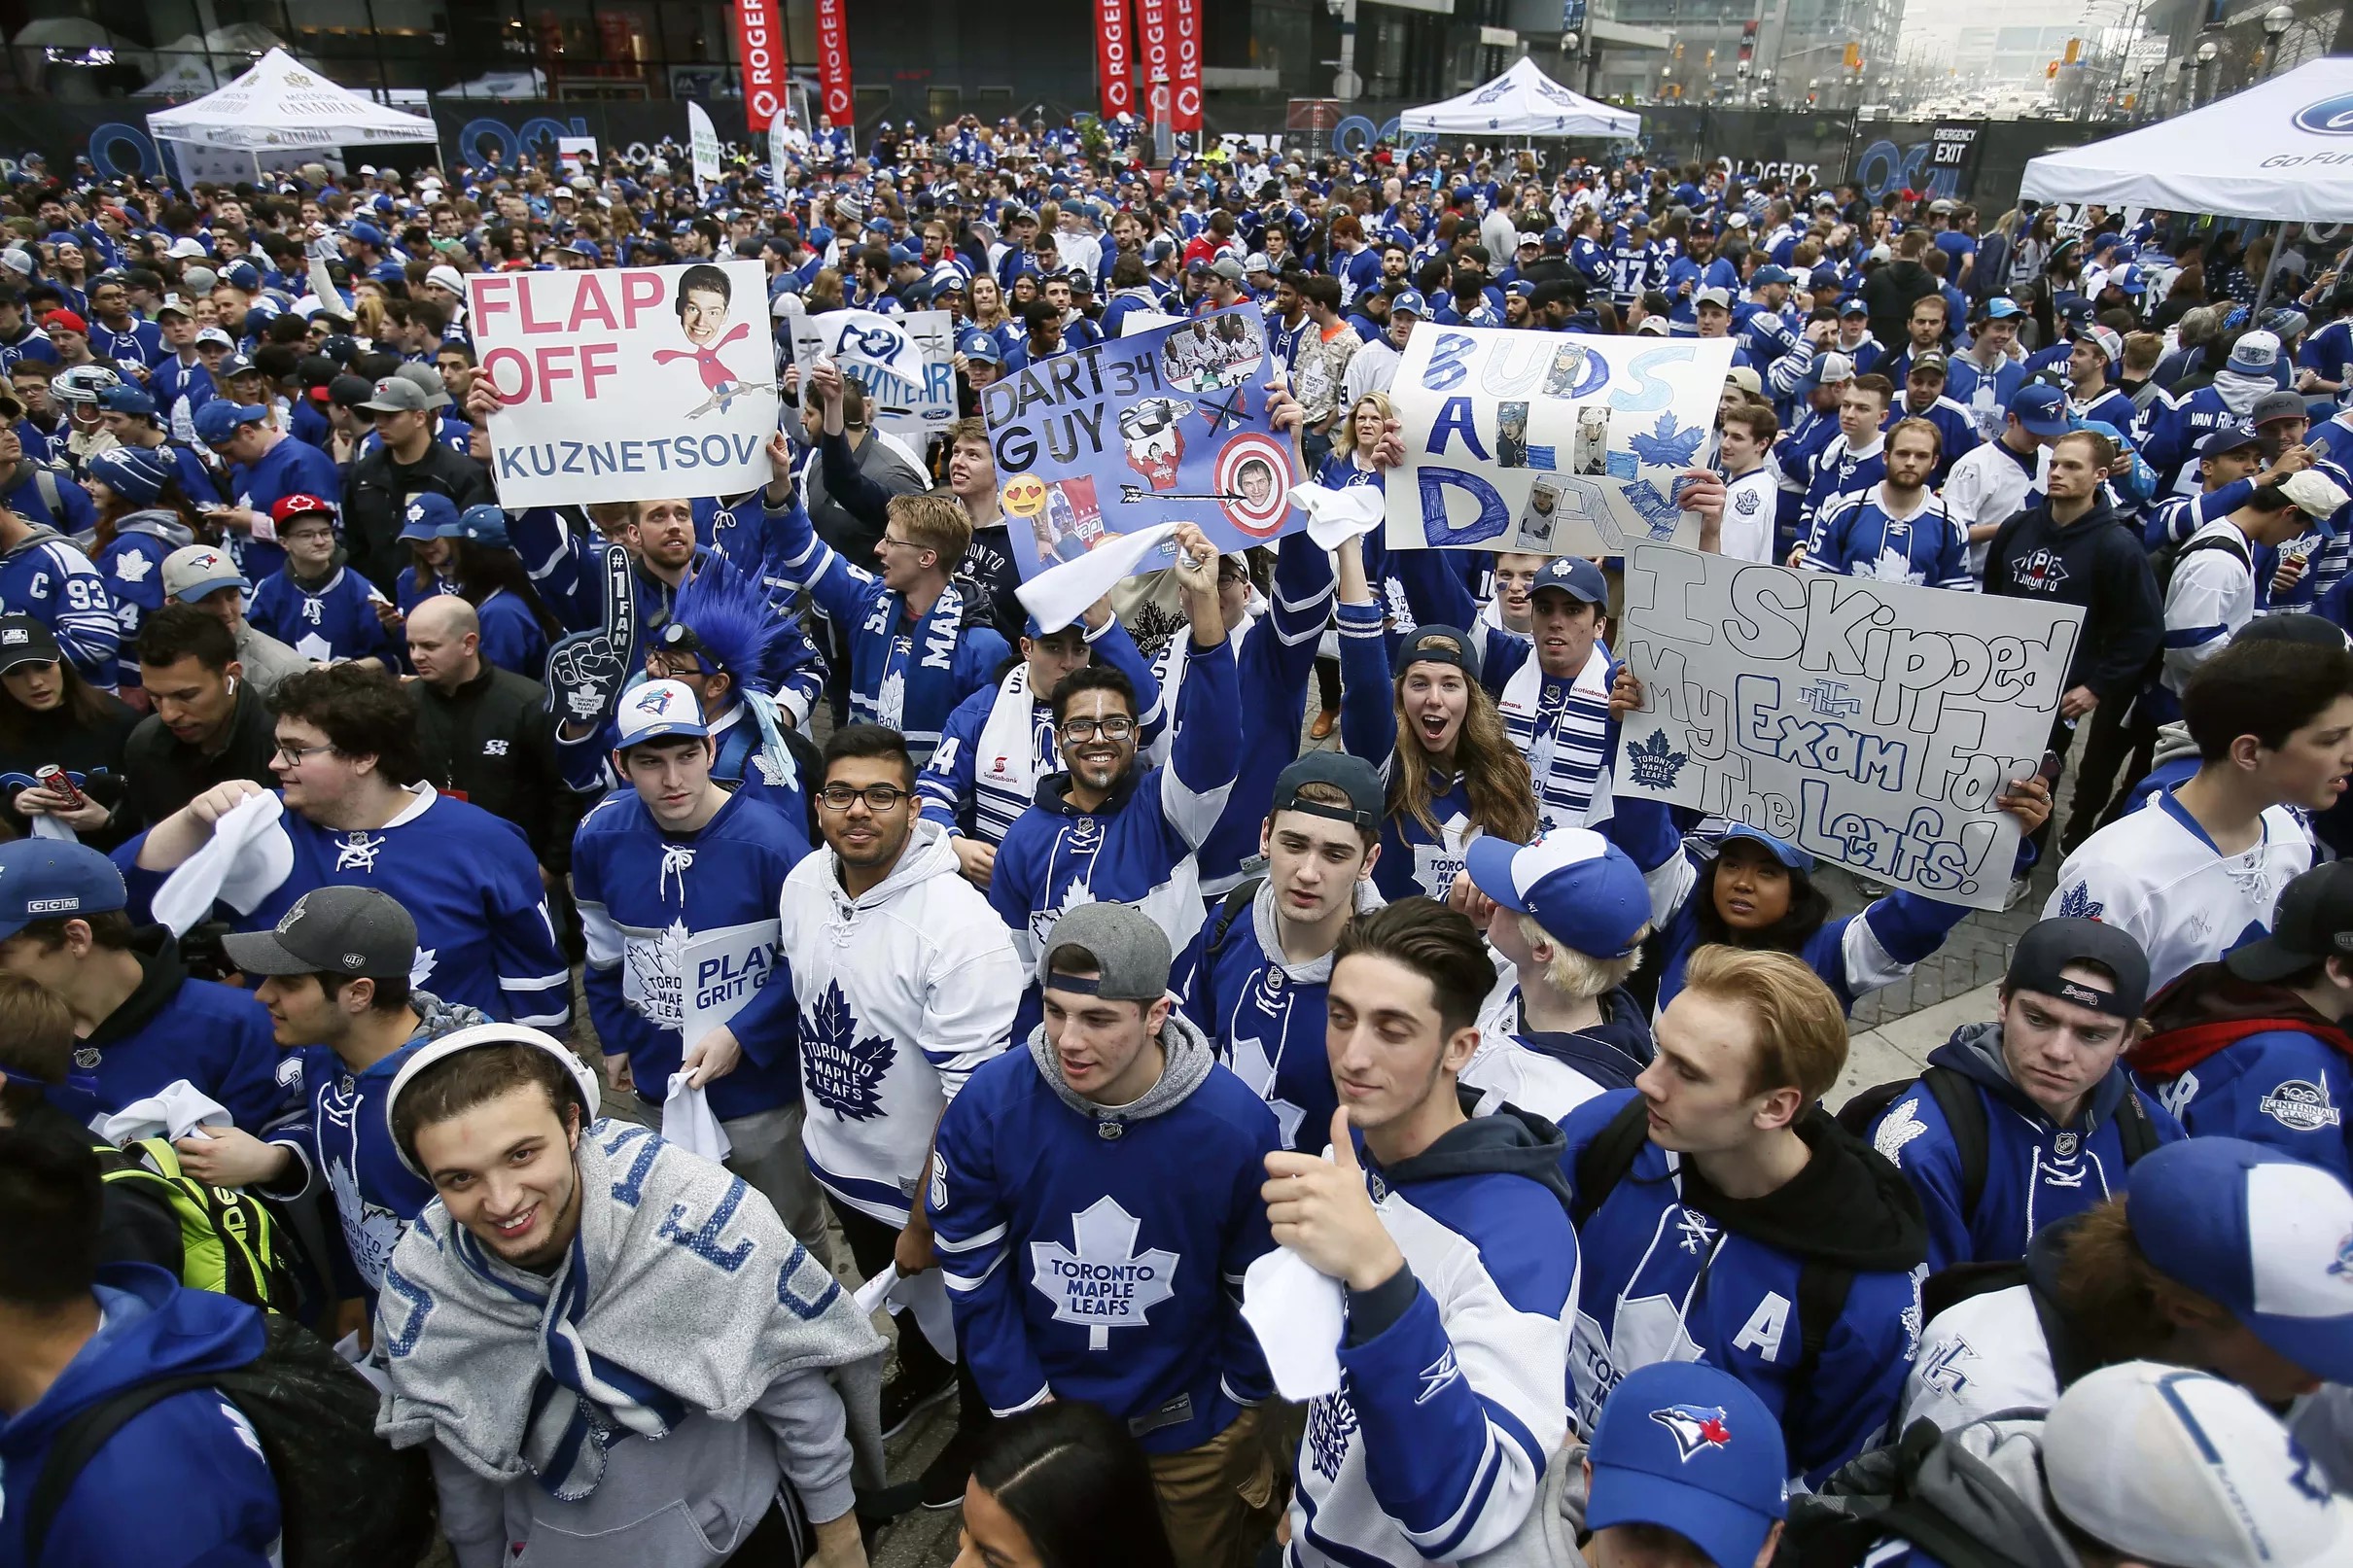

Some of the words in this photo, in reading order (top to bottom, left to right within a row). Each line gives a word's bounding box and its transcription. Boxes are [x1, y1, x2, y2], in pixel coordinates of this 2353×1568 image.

[278, 101, 367, 115] CANADIAN
[1933, 128, 1977, 142] EMERGENCY
[1934, 144, 1966, 163] EXIT
[1593, 258, 1607, 276] 19
[1612, 261, 1647, 292] 47
[472, 271, 665, 337] FLAP
[482, 343, 618, 405] OFF
[1306, 374, 1324, 385] TORONTO
[1421, 332, 1697, 412] BUDS
[980, 345, 1106, 431] DART
[1306, 380, 1319, 390] MAPLE
[926, 409, 947, 419] Ford
[2191, 412, 2214, 427] VAN
[996, 402, 1105, 473] GUY
[499, 434, 758, 479] KUZNETSOV
[1418, 466, 1700, 552] DAY
[30, 572, 50, 599] C
[67, 579, 109, 610] 93
[1628, 544, 1714, 645] I
[614, 601, 630, 646] FAN
[1571, 685, 1609, 700] Scotiabank
[483, 747, 508, 755] 24
[1637, 755, 1675, 771] TORONTO
[1641, 763, 1668, 774] MAPLE
[983, 772, 1018, 784] Scotiabank
[1640, 770, 1668, 781] LEAFS
[30, 899, 78, 911] CCM
[649, 976, 683, 990] TORO
[696, 976, 748, 1010] GRIT
[805, 1041, 874, 1078] TORONTO
[814, 1059, 861, 1087] MAPLE
[816, 1073, 862, 1101] LEAFS
[2267, 1098, 2335, 1119] CENTENNIAL
[2282, 1110, 2320, 1124] CLASSIC
[2287, 1118, 2312, 1127] TORONTO
[1051, 1259, 1155, 1281] TORONTO
[1066, 1279, 1135, 1299] MAPLE
[1071, 1298, 1130, 1316] LEAFS
[1732, 1290, 1791, 1363] A
